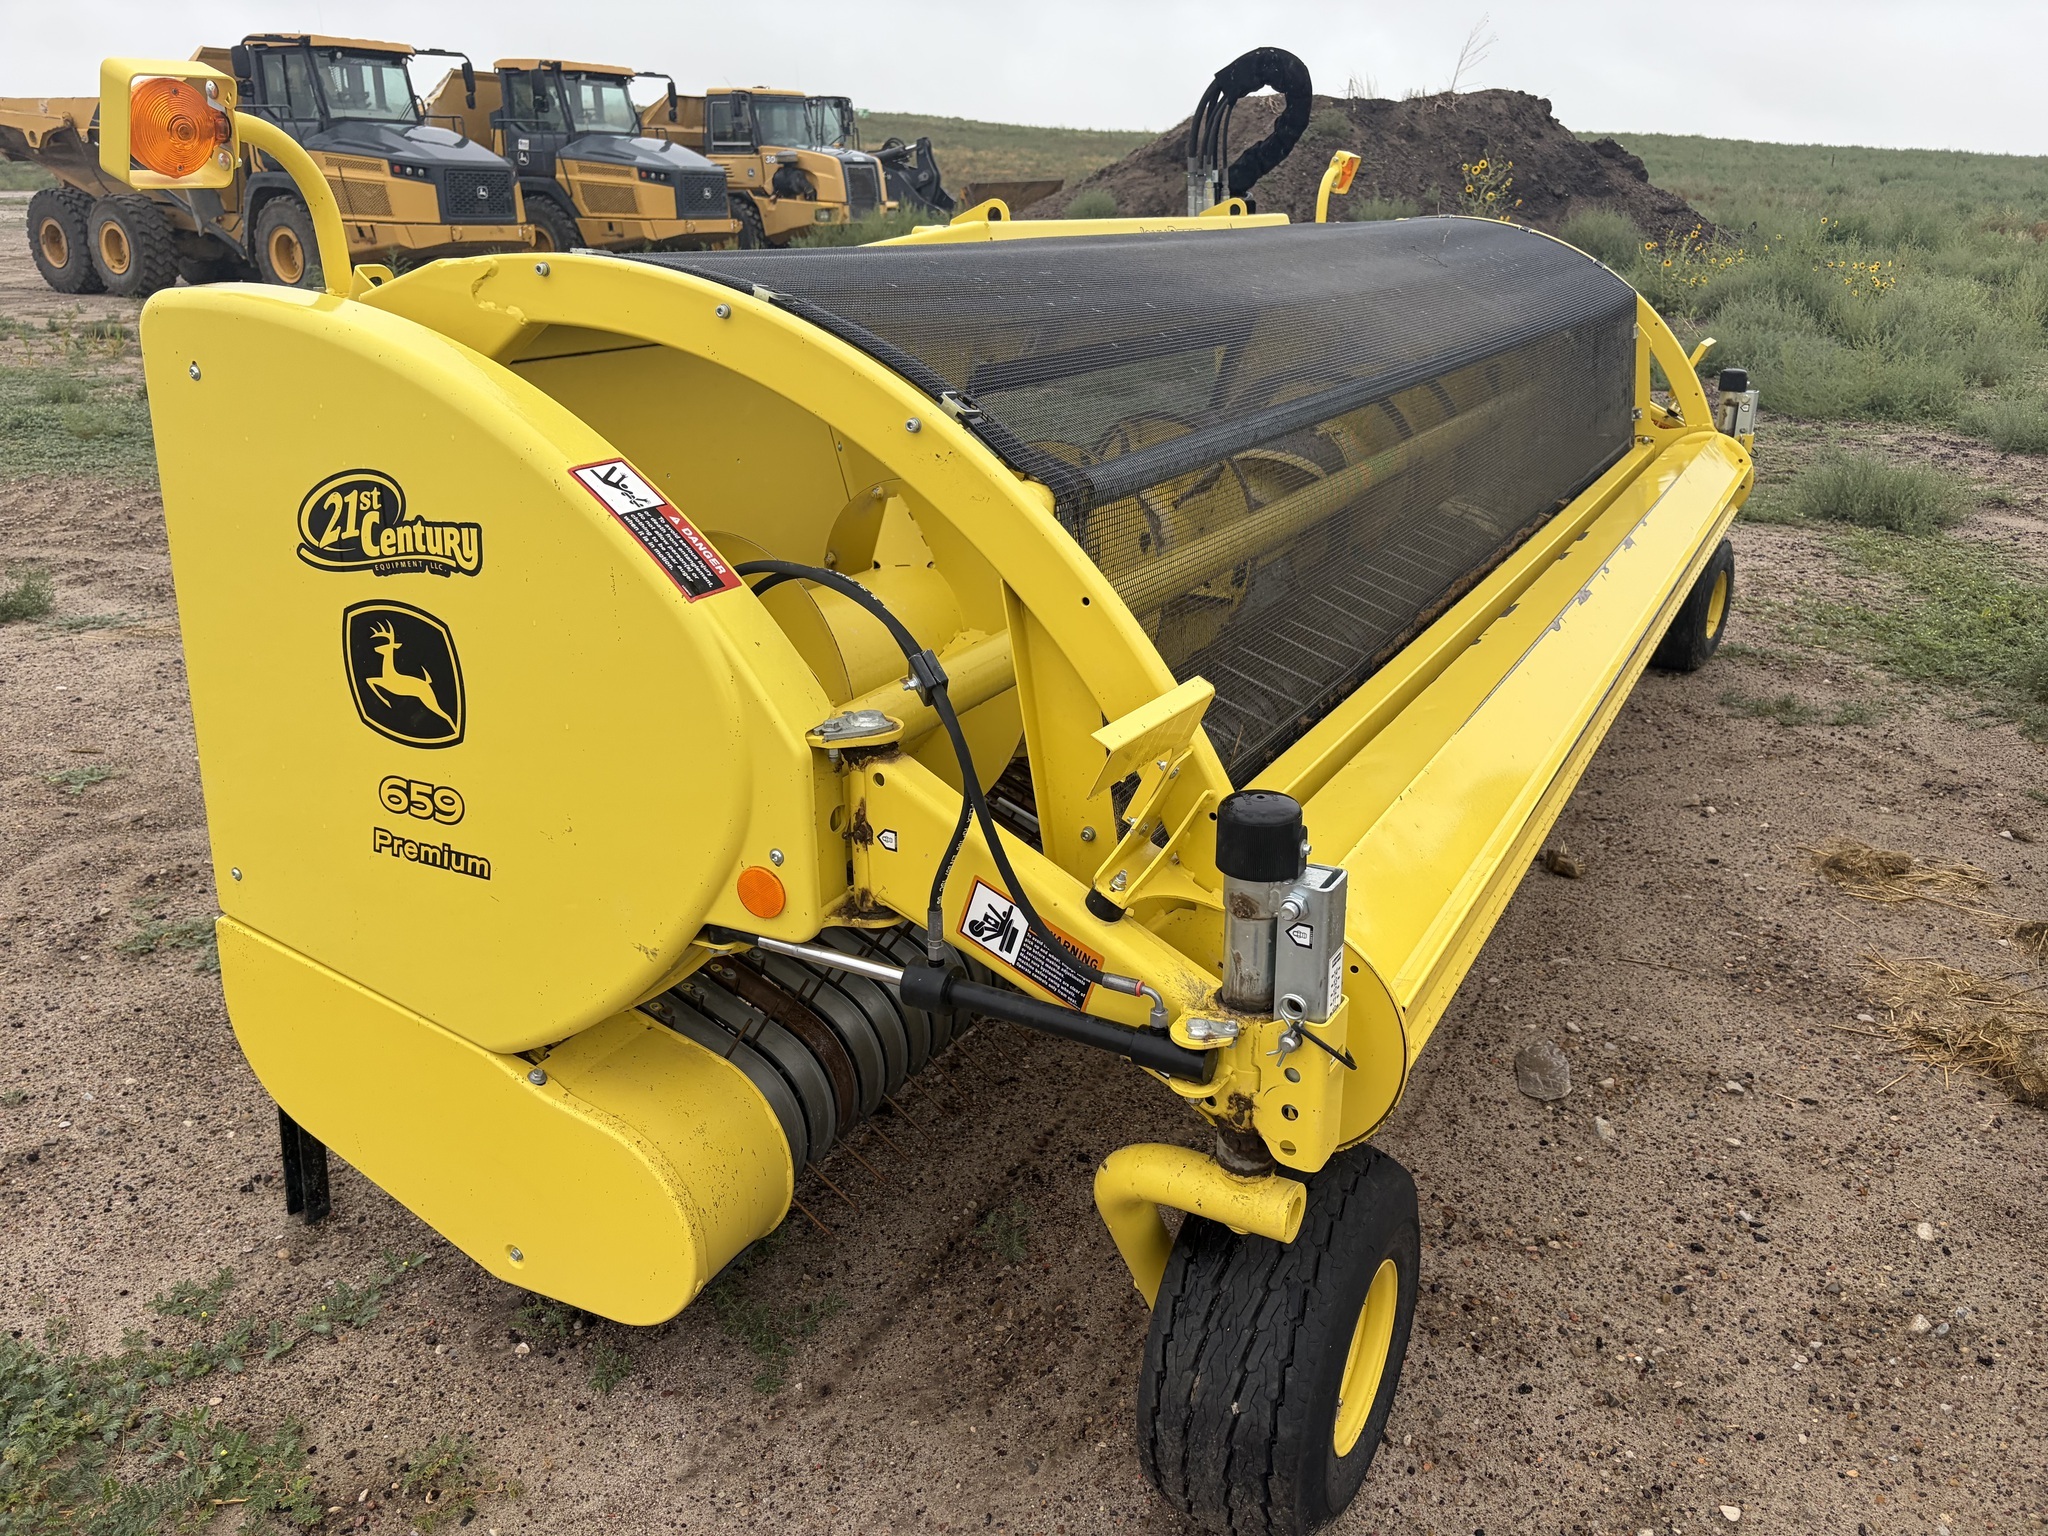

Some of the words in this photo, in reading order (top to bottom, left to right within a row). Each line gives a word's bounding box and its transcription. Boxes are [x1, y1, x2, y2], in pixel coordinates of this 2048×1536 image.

[765, 155, 777, 164] 30
[319, 487, 382, 548] 21st
[624, 515, 640, 531] when
[654, 548, 674, 571] motion.
[637, 512, 646, 520] do
[645, 520, 656, 530] not
[654, 530, 670, 545] allow
[667, 545, 694, 572] person(s)
[374, 560, 422, 571] EQUIPMENT
[430, 562, 447, 572] LLC.
[630, 514, 653, 536] clothing
[657, 543, 666, 551] be
[665, 551, 679, 564] near
[677, 565, 694, 582] auger
[650, 517, 667, 534] death
[665, 533, 679, 547] from
[678, 547, 713, 588] entanglement,
[658, 516, 666, 524] To
[664, 524, 681, 539] avoid
[679, 539, 699, 560] serious
[697, 560, 713, 577] injury
[681, 527, 726, 575] DANGER
[379, 775, 465, 825] 659
[374, 826, 490, 880] Premium
[1051, 931, 1098, 970] ARNING
